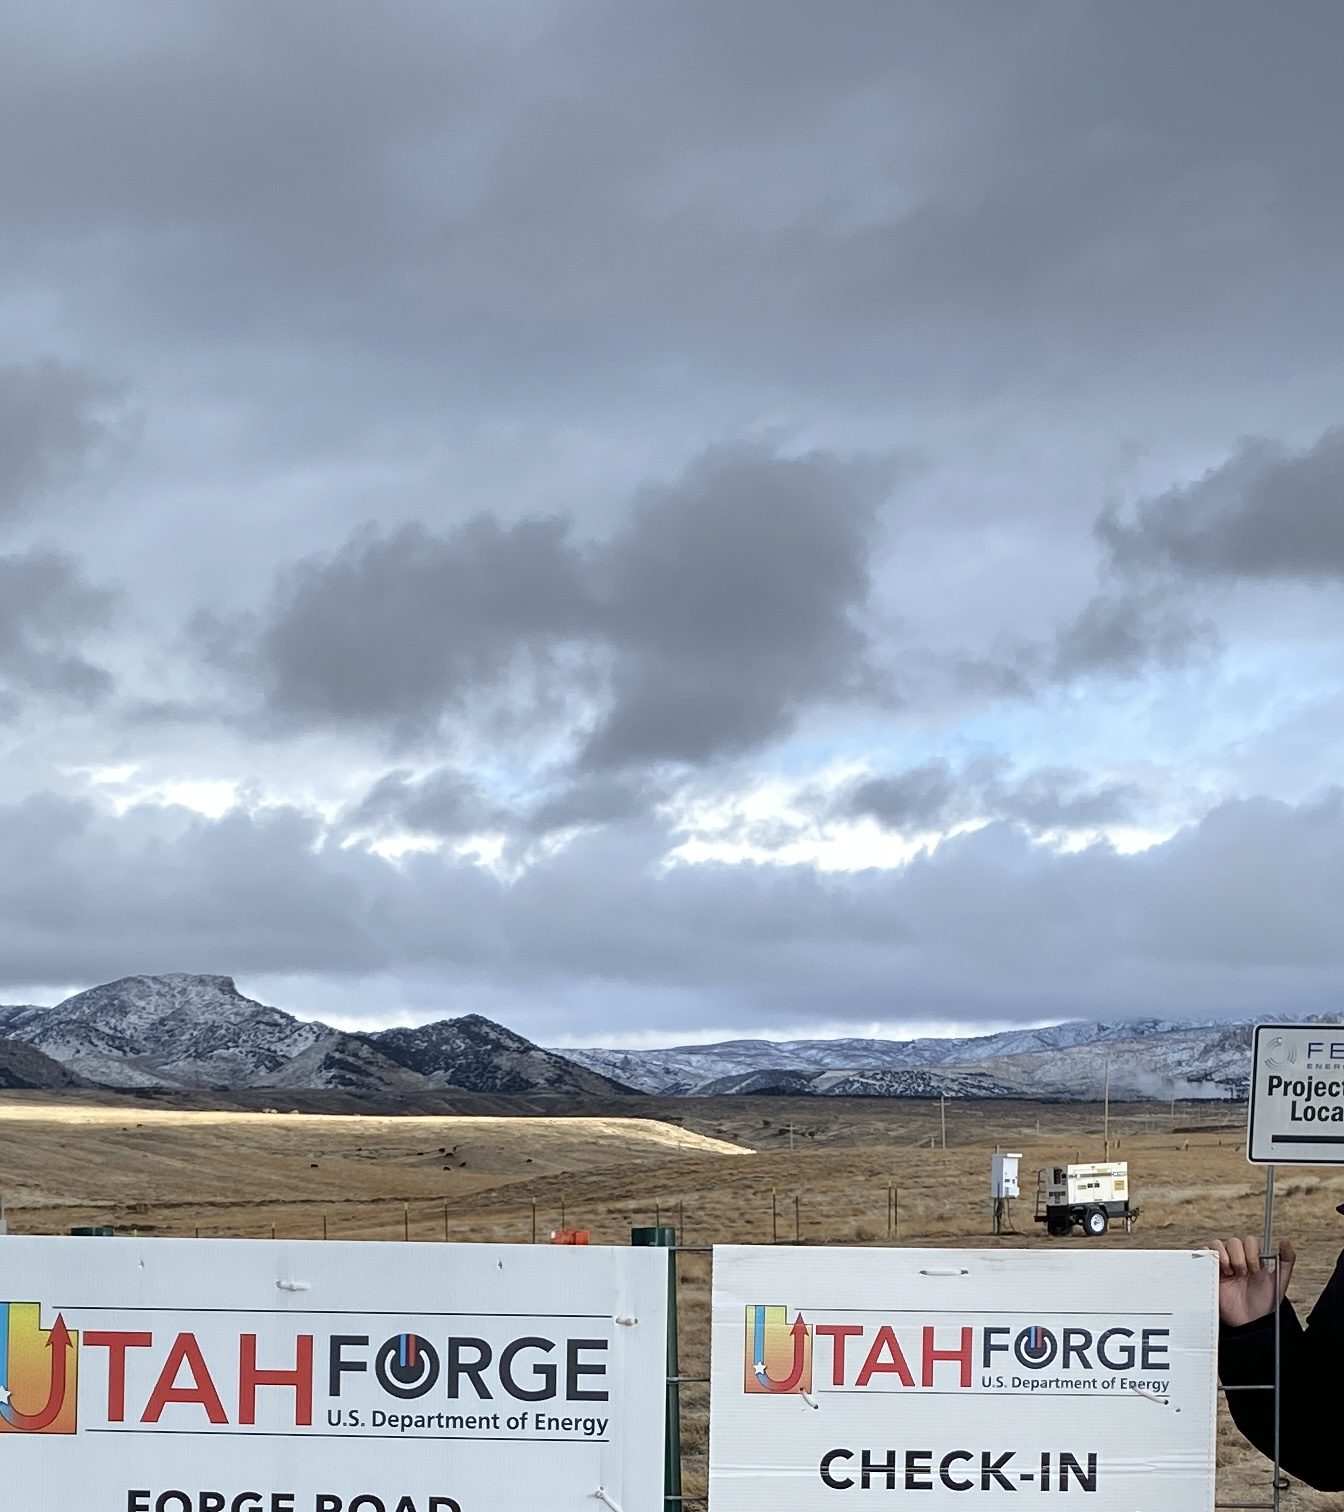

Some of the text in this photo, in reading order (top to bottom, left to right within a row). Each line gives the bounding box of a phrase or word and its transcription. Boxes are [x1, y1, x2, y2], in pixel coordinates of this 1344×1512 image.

[981, 1375, 1170, 1393] U.S. Department of Energy
[327, 1409, 609, 1437] U.S. Department of Energy
[820, 1448, 1097, 1493] CHECK-IN
